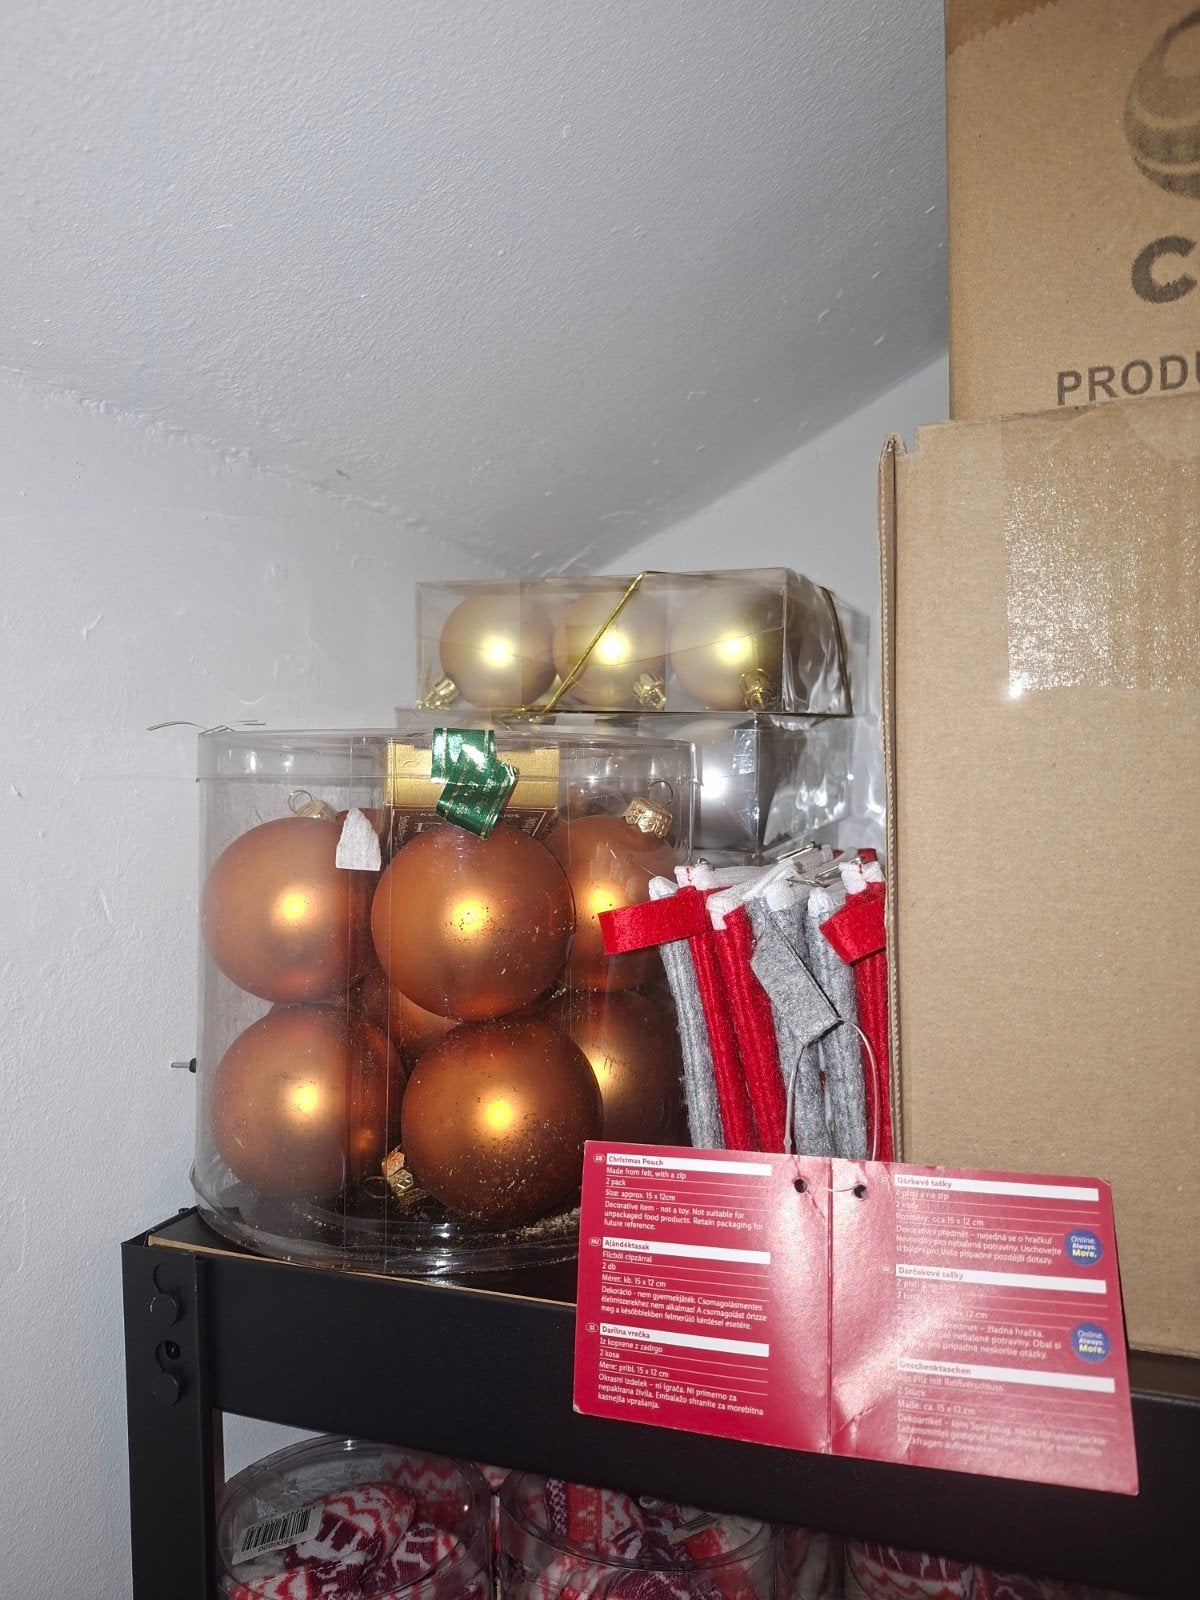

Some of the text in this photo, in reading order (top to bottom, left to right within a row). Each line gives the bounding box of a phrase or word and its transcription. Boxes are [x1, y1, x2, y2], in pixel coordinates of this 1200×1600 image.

[1057, 351, 1200, 405] PROD
[608, 1156, 640, 1164] Christmas
[625, 1168, 639, 1176] from
[641, 1169, 653, 1177] felt,
[654, 1170, 668, 1178] with
[676, 1172, 686, 1180] zip
[611, 1178, 625, 1187] pack
[897, 1177, 951, 1188] Dárkové tašky
[621, 1191, 644, 1199] approx.
[659, 1193, 675, 1201] 12cm
[937, 1192, 949, 1201] zip
[604, 1200, 637, 1209] Decorative
[639, 1203, 654, 1211] item
[660, 1205, 671, 1213] not
[678, 1207, 690, 1215] toy.
[706, 1209, 732, 1218] suitable
[734, 1211, 744, 1219] for
[604, 1210, 642, 1220] unpackaged
[660, 1215, 691, 1225] products.
[693, 1217, 714, 1225] Retain
[716, 1220, 752, 1230] packaging
[604, 1219, 655, 1229] future reference.
[962, 1217, 970, 1225] 12
[977, 1231, 1006, 1241] nejedná
[1024, 1235, 1051, 1244] hračku!
[604, 1240, 649, 1250] Ajándéktasak
[983, 1242, 1018, 1252] potraviny.
[1020, 1245, 1061, 1255] Uschovejte
[993, 1253, 1025, 1263] pozdější
[1026, 1255, 1052, 1265] dotazy.
[1072, 1249, 1097, 1258] More.
[602, 1273, 621, 1282] Méret:
[648, 1278, 654, 1286] 12
[898, 1267, 963, 1280] Darčekové tašky
[601, 1286, 631, 1296] Dekoráció
[697, 1297, 762, 1312] Csomagolásmentes
[600, 1305, 614, 1313] meg
[725, 1319, 751, 1329] esetére.
[696, 1306, 701, 1314] A
[702, 1308, 744, 1320] csomagolást
[602, 1325, 649, 1338] Darilna vrečka
[1014, 1327, 1043, 1337] hračka.
[607, 1339, 633, 1350] koprene
[640, 1343, 662, 1354] zadrgo
[953, 1332, 1061, 1349] nebalené potraviny. Obal si
[604, 1350, 619, 1358] kosa
[980, 1345, 1017, 1355] neskoršie
[1019, 1349, 1047, 1359] otázky.
[1078, 1344, 1105, 1354] More.
[598, 1361, 617, 1370] Mere:
[636, 1366, 643, 1374] 15
[650, 1368, 657, 1376] 12
[598, 1373, 623, 1383] Okrasni
[624, 1377, 647, 1387] izdelek
[686, 1386, 694, 1394] Ni
[695, 1389, 727, 1400] primerno
[929, 1376, 942, 1385] mit
[904, 1387, 925, 1396] Stück
[597, 1392, 659, 1409] kasnejša vprašanja.
[598, 1383, 633, 1395] nepakirana
[655, 1391, 687, 1403] Embalažo
[688, 1396, 715, 1407] shranite
[727, 1403, 763, 1415] morebitna
